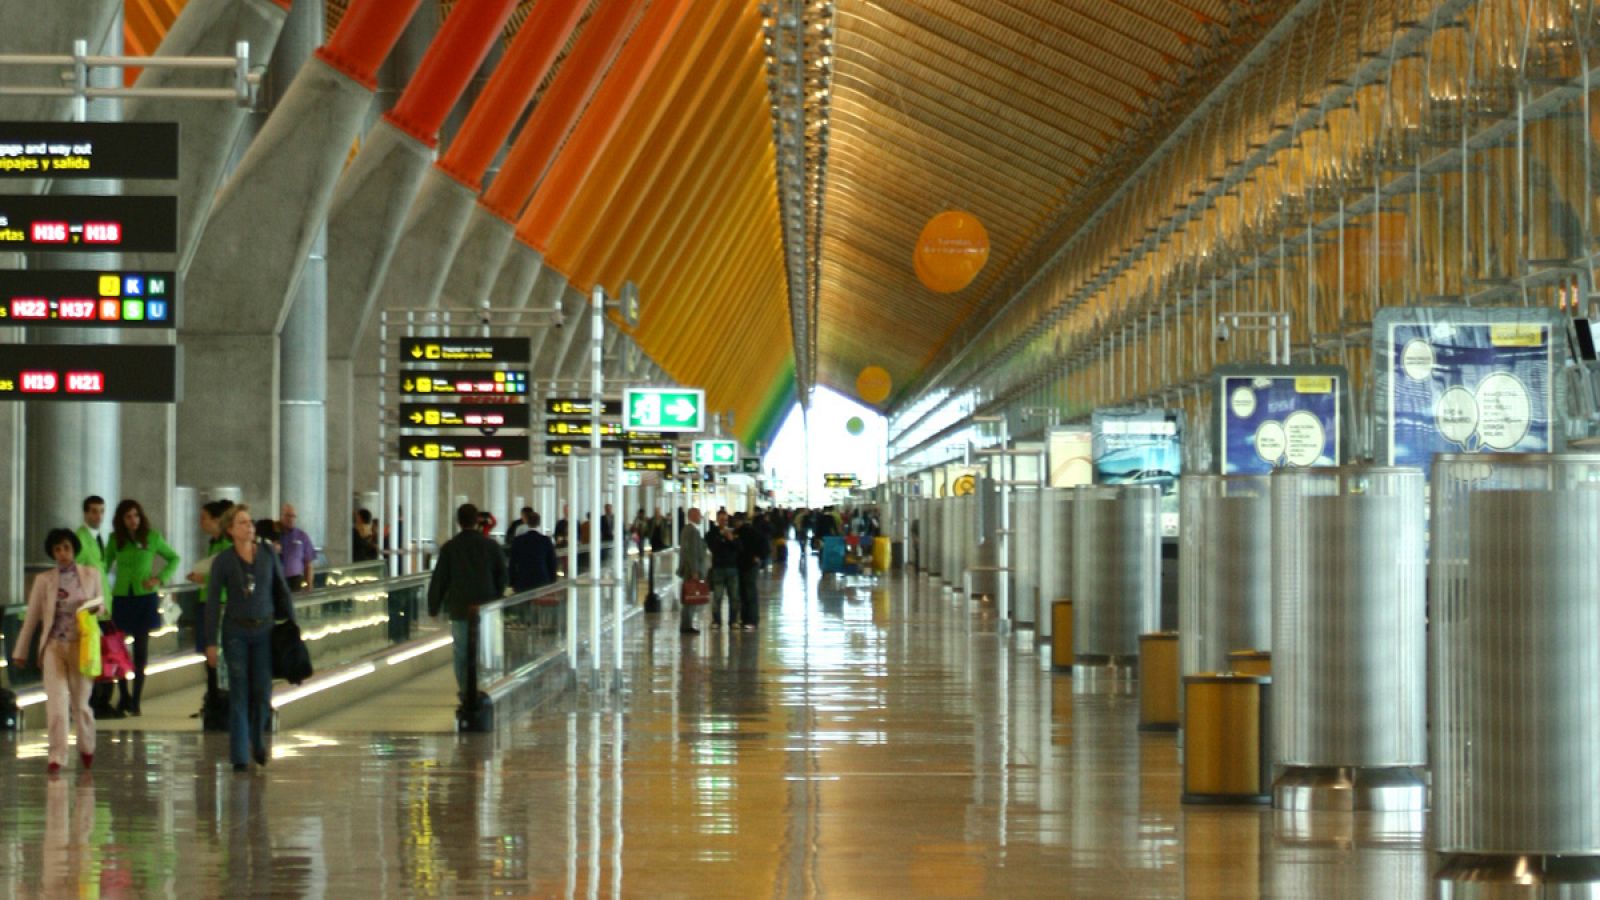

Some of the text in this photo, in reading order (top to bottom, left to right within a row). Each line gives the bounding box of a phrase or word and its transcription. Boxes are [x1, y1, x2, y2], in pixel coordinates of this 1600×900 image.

[25, 143, 47, 155] and
[48, 144, 72, 157] way
[72, 143, 92, 155] out
[41, 159, 50, 172] y
[52, 156, 90, 169] salida
[35, 224, 66, 241] H16
[86, 224, 118, 241] H18
[126, 279, 140, 294] K
[149, 279, 165, 294] M
[13, 300, 46, 317] H22
[60, 301, 94, 318] H37
[103, 300, 116, 317] R
[127, 301, 140, 318] S
[150, 302, 164, 318] U
[23, 373, 101, 391] H19 H21
